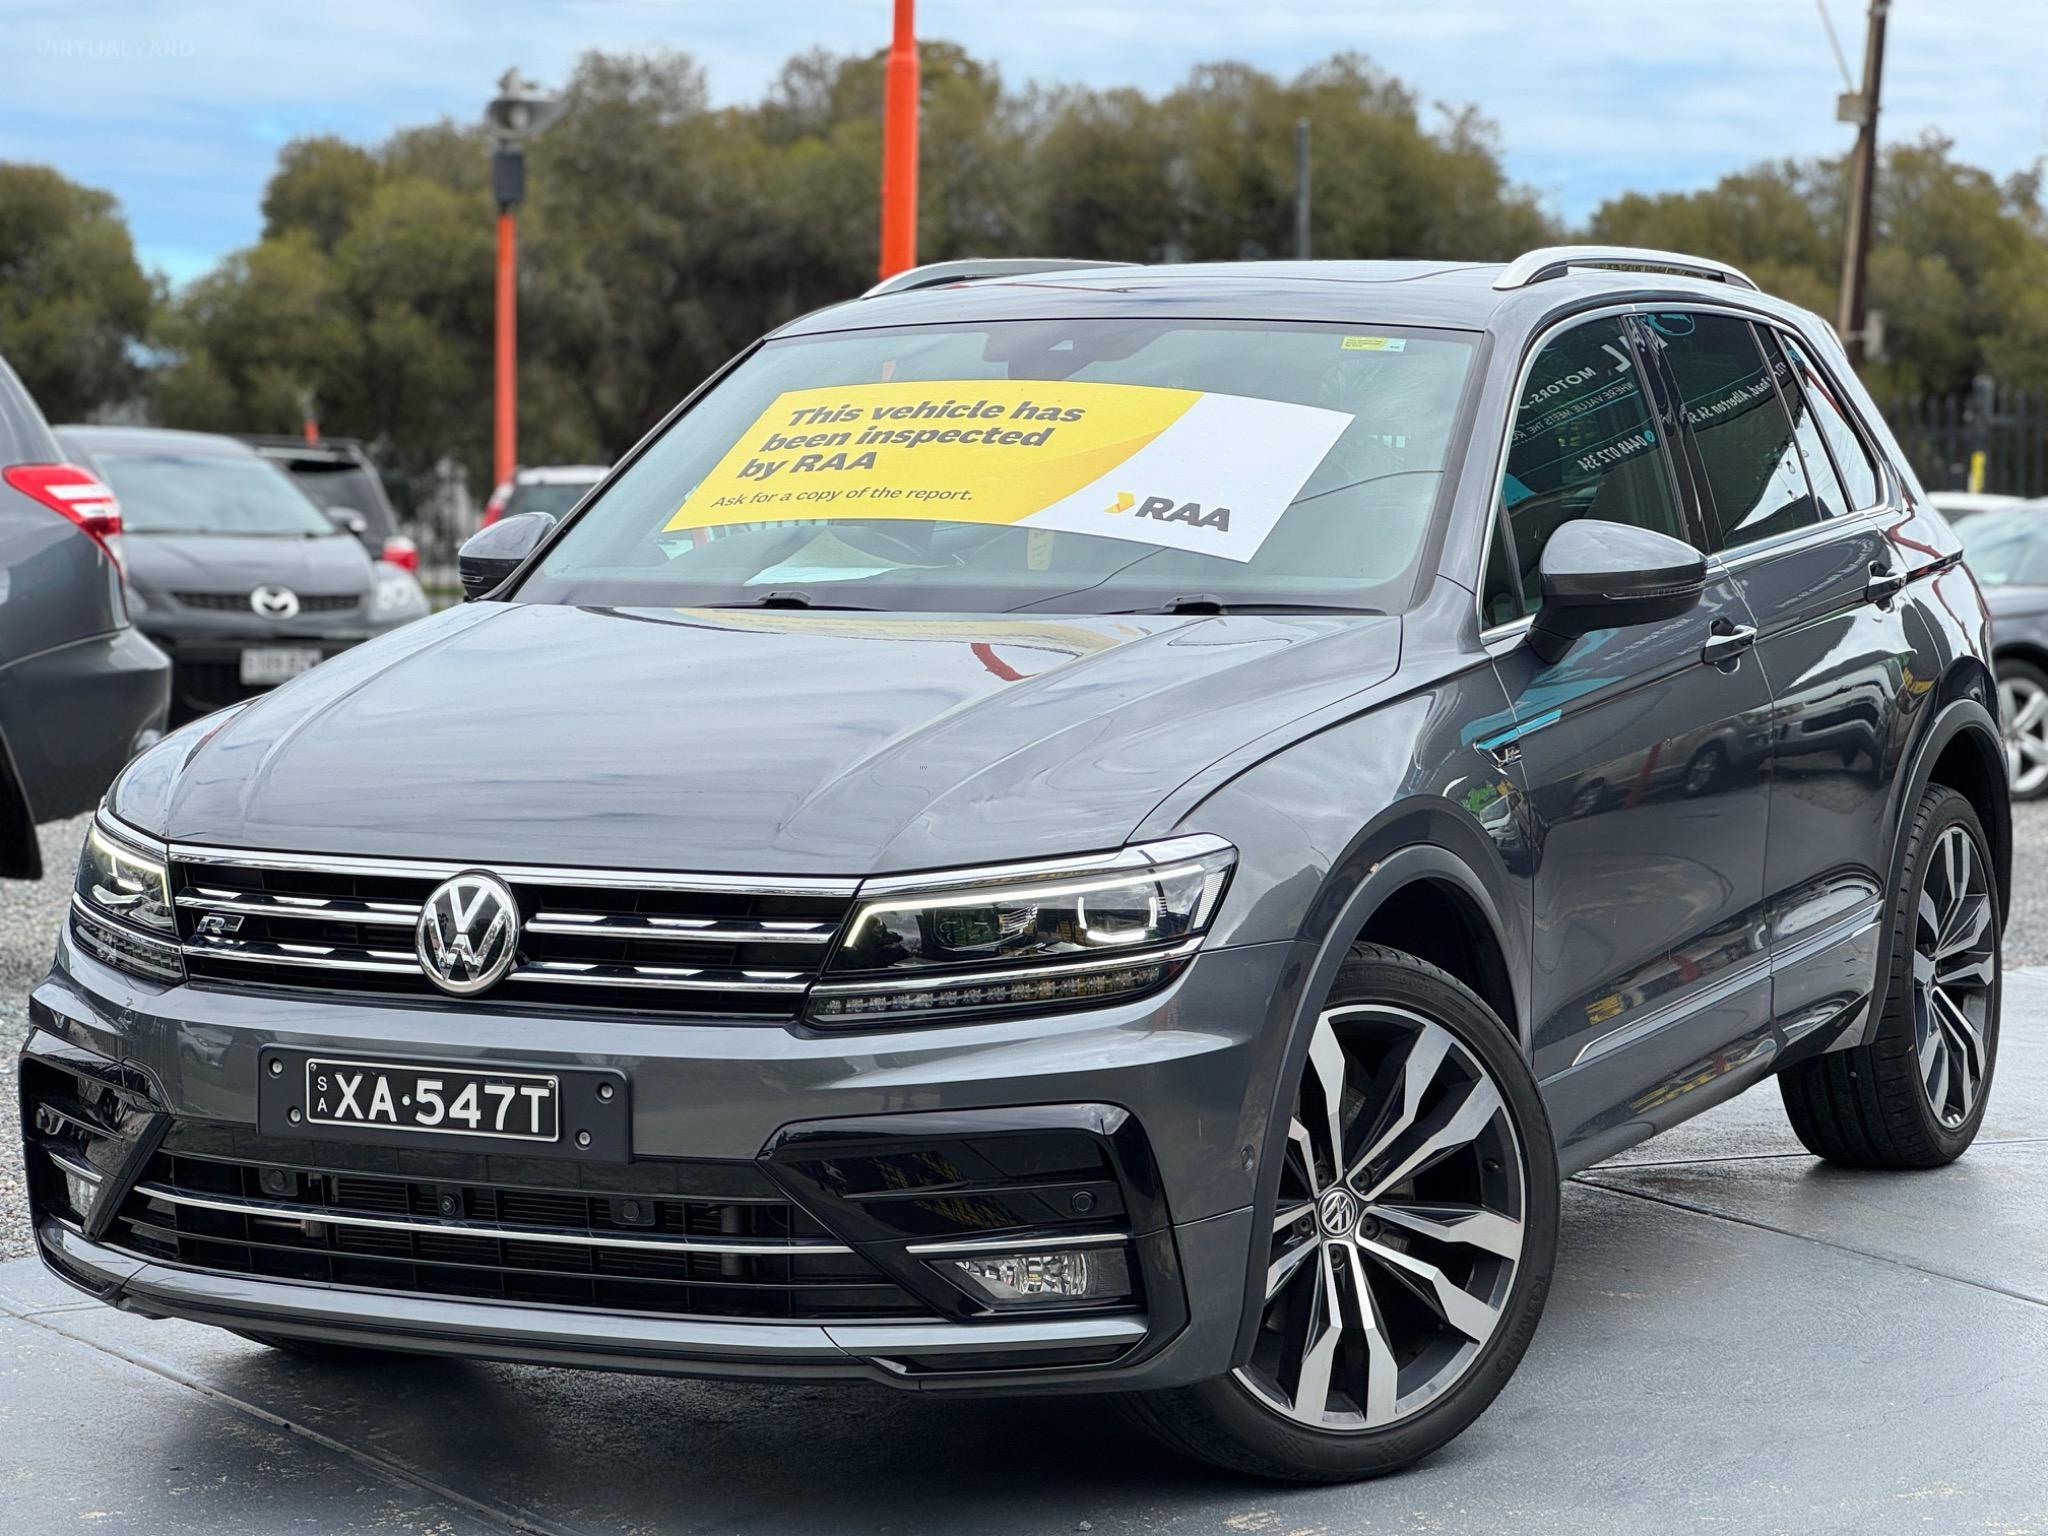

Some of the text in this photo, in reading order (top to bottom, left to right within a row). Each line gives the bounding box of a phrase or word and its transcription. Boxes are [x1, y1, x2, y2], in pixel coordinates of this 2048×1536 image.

[788, 400, 1087, 427] This vehicle has
[759, 426, 1055, 453] been inspected
[736, 452, 878, 481] by RAA
[711, 486, 973, 508] Ask for a copy of the report.
[1134, 496, 1231, 532] RAA
